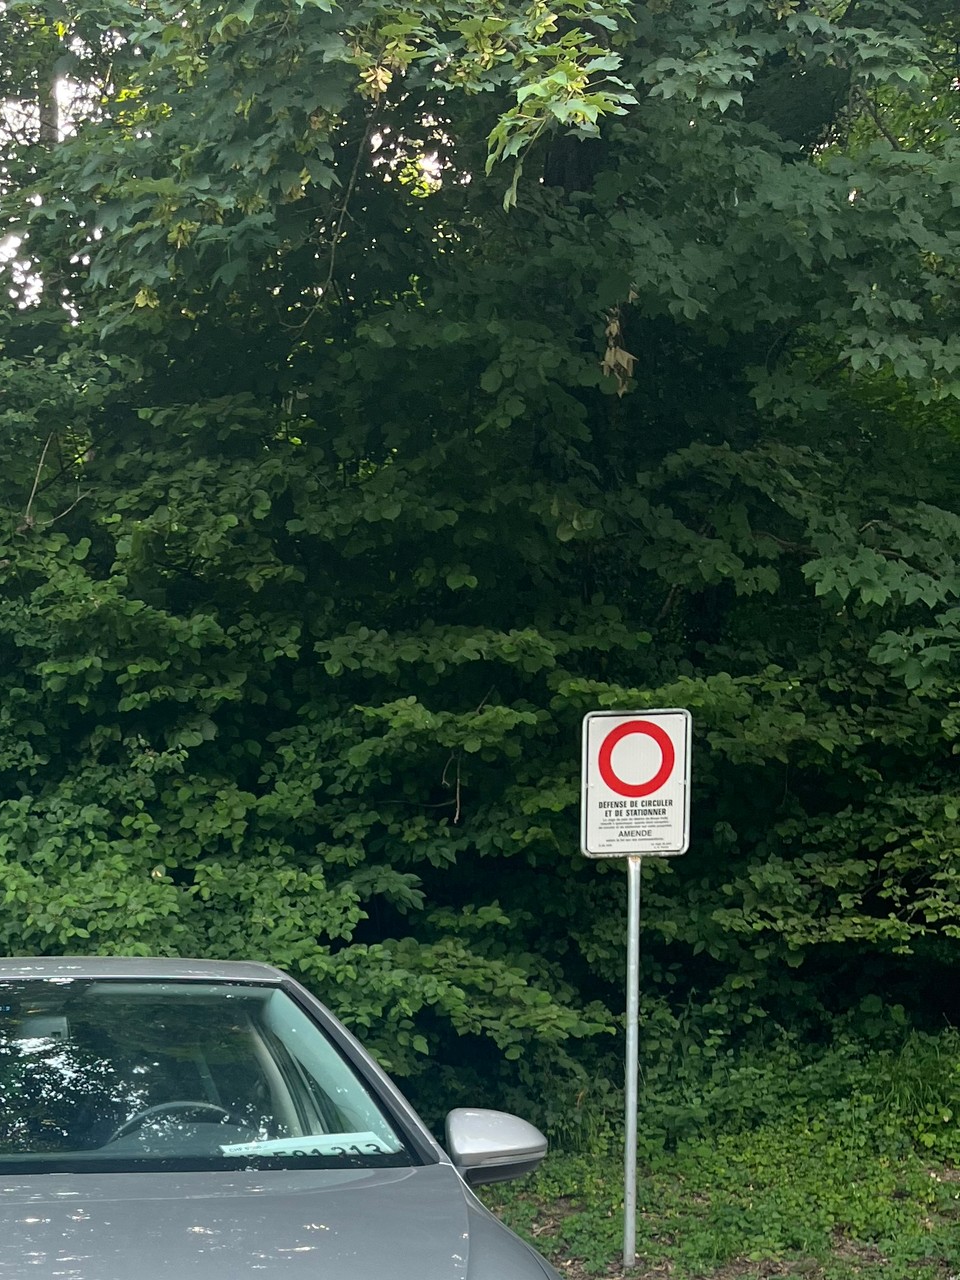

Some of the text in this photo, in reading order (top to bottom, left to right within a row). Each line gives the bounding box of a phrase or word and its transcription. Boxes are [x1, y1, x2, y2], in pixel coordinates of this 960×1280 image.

[629, 800, 638, 808] DE
[615, 809, 622, 817] DE
[626, 808, 666, 816] STATIONNER
